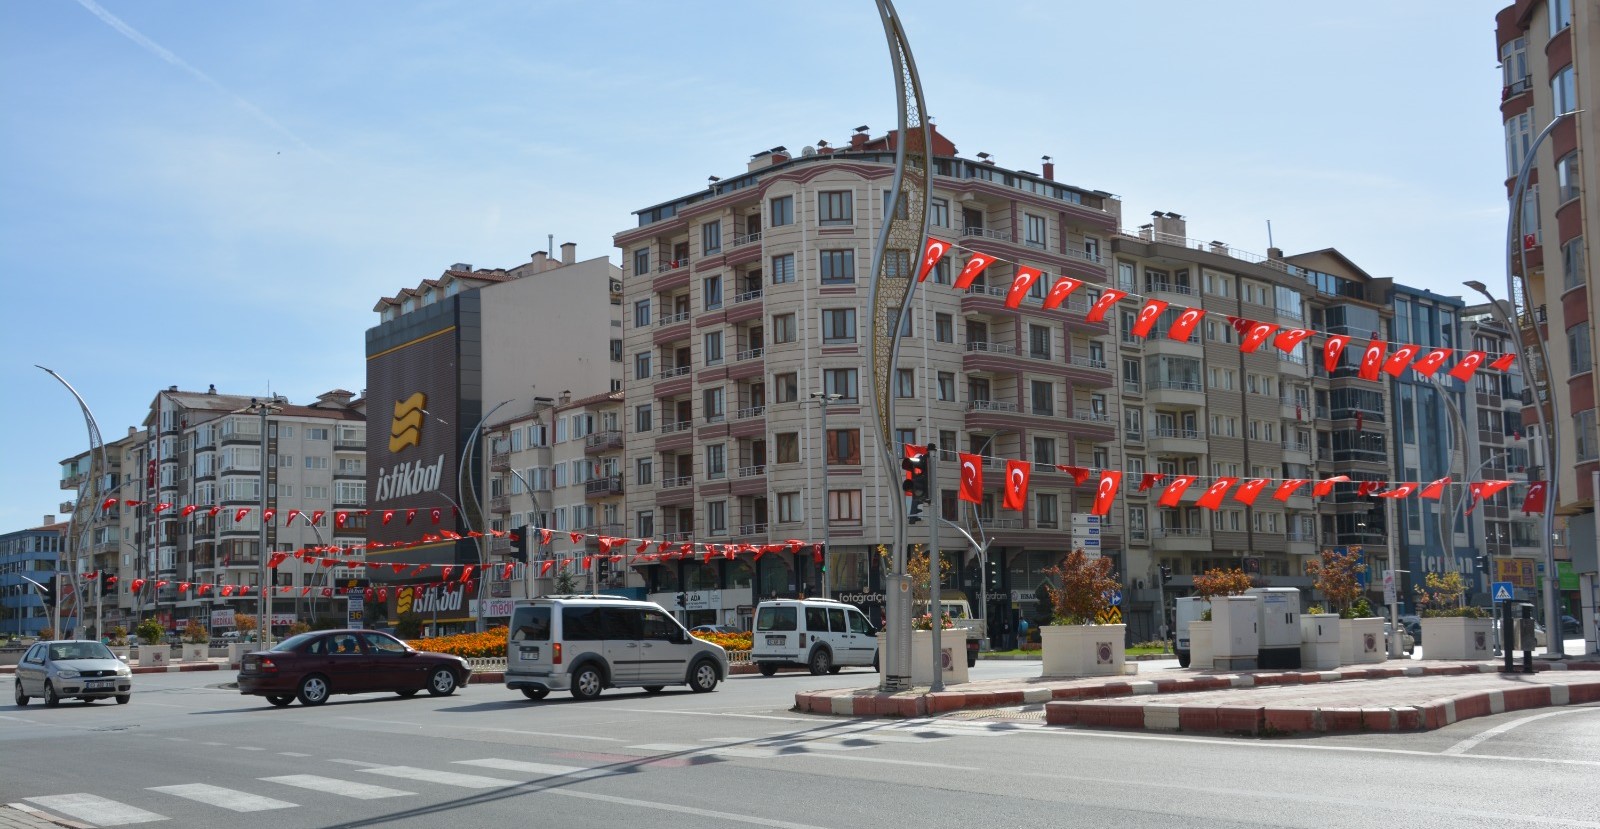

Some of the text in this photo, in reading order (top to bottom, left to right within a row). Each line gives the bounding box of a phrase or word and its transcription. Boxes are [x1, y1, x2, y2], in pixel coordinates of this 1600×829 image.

[1412, 367, 1453, 387] teran
[375, 453, 445, 502] istikbal
[839, 592, 886, 604] fotoğrafçı
[490, 601, 514, 615] medi
